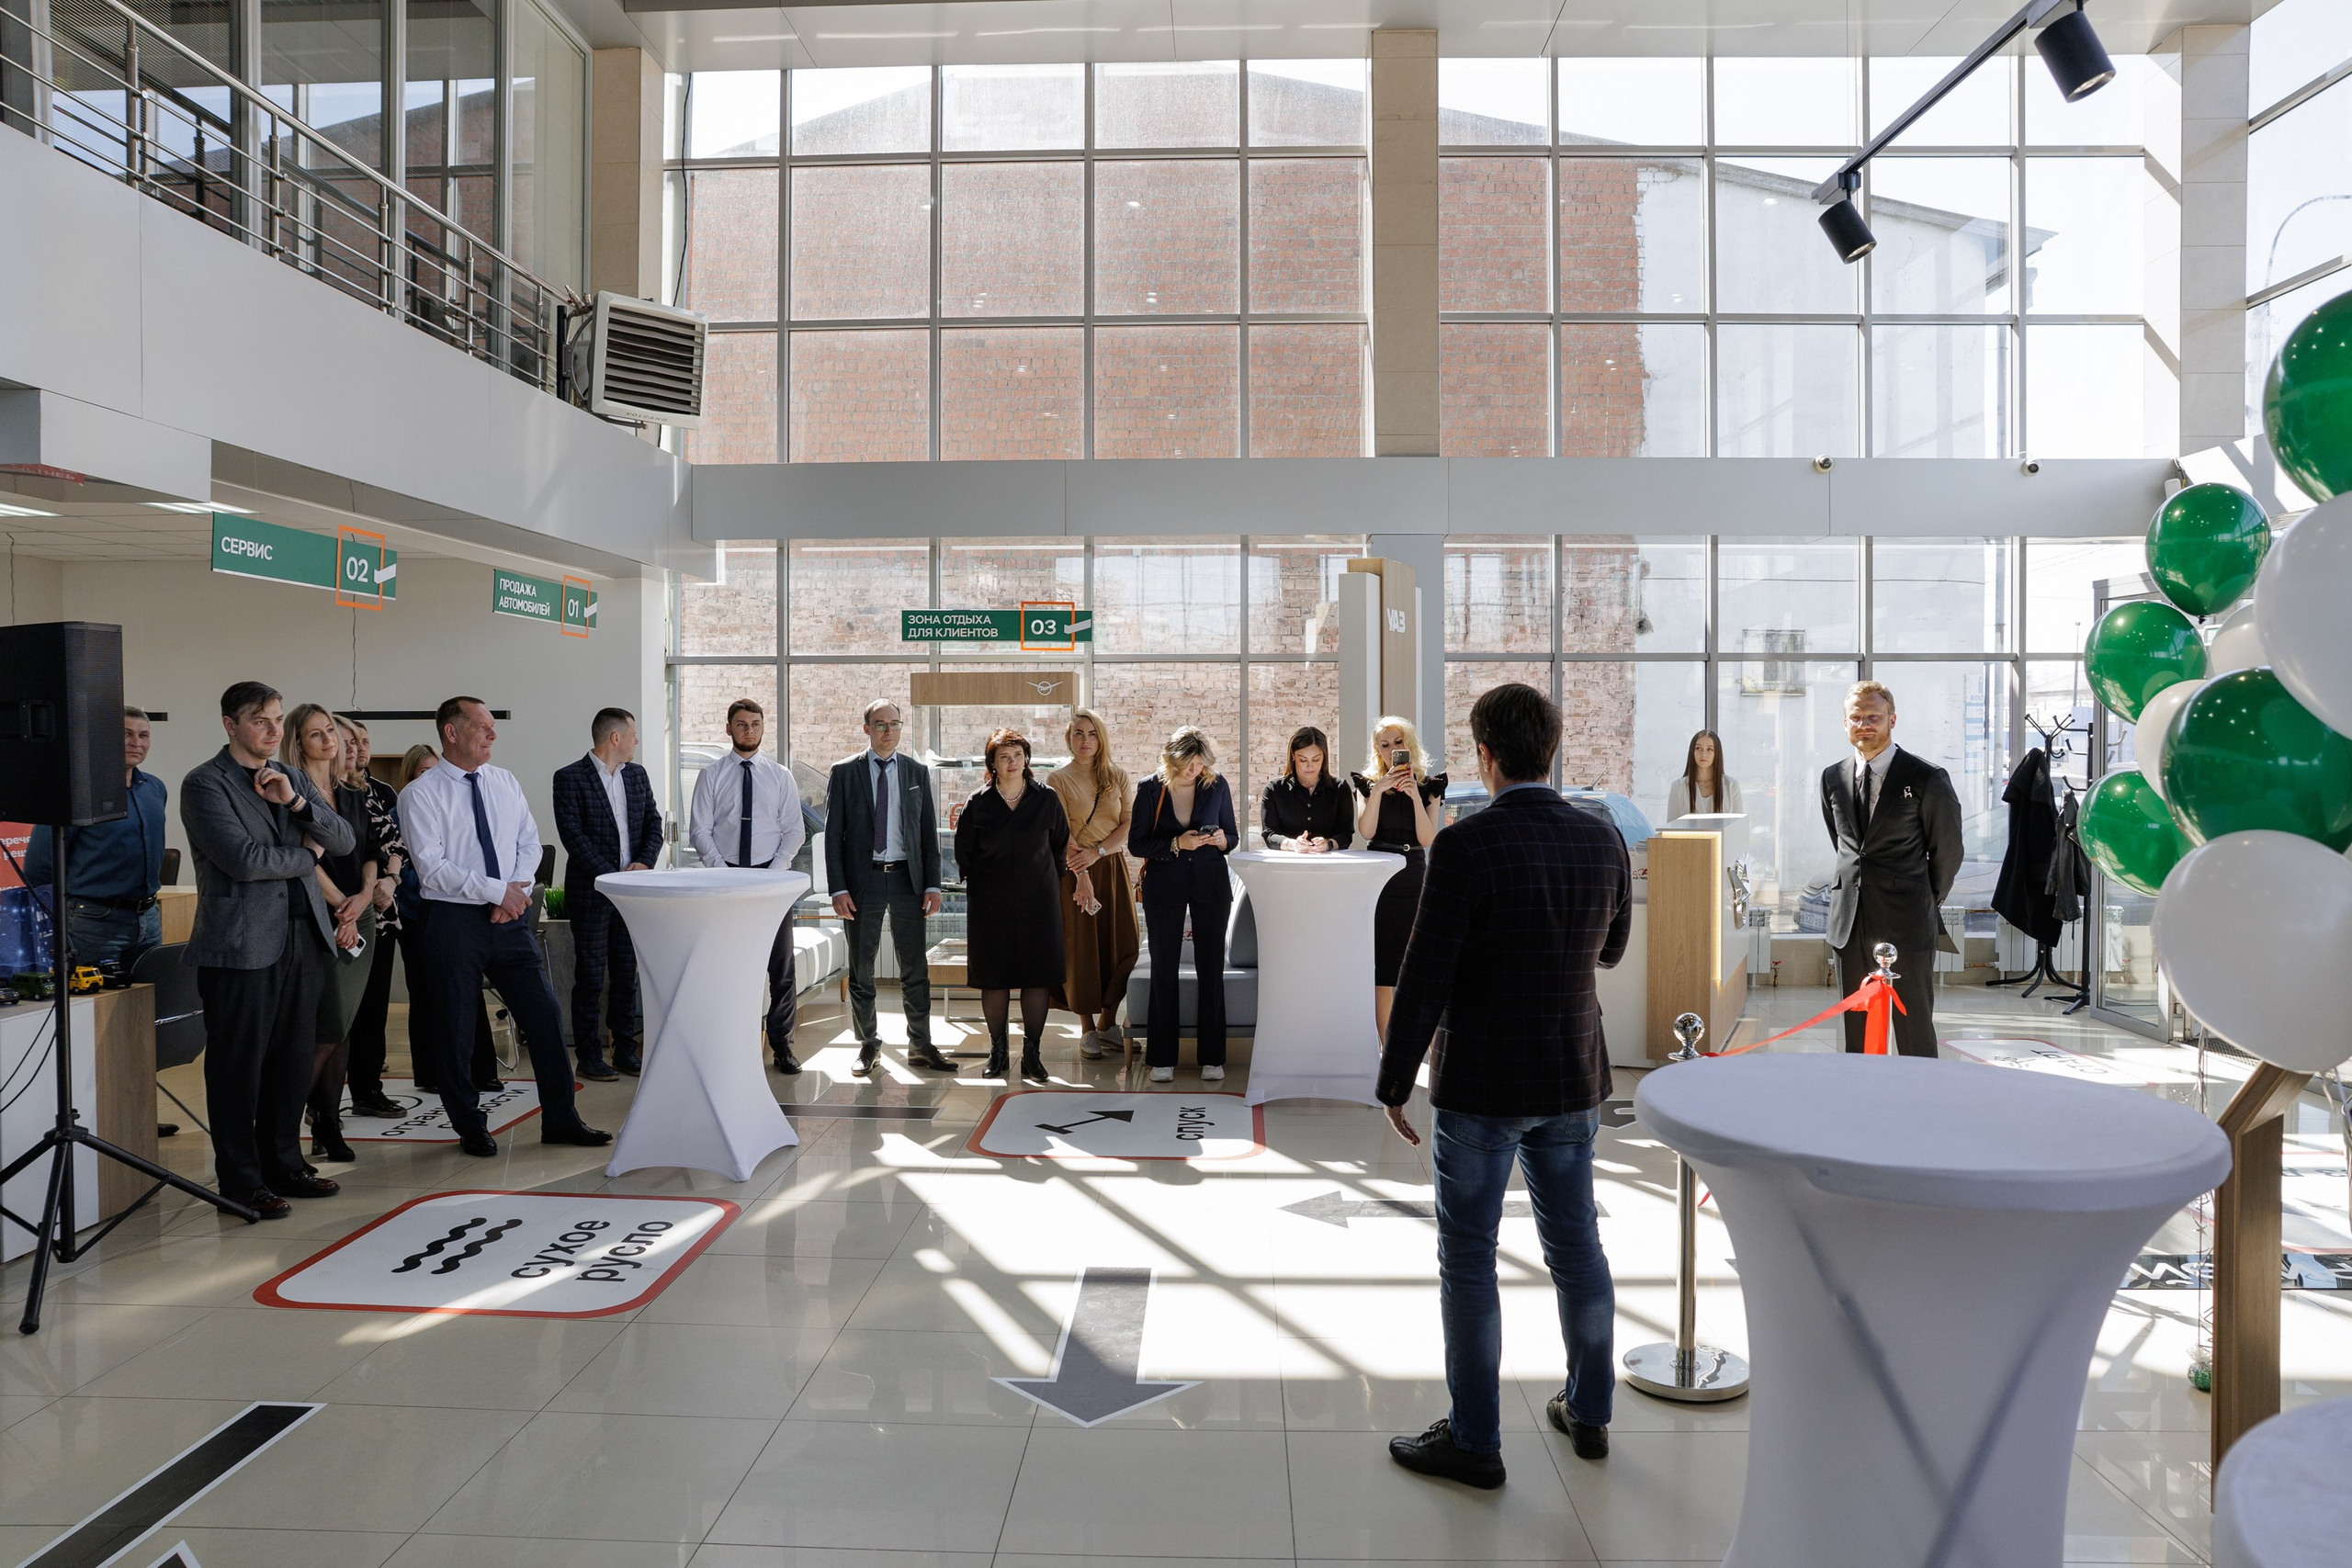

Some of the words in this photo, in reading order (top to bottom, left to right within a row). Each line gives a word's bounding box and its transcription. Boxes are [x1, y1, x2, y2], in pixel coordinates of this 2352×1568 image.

[220, 536, 273, 560] СЕРВИС
[346, 557, 368, 582] 02
[499, 578, 537, 597] ПРОДАЖА
[499, 596, 550, 616] АВТОМОБИЛЕЙ
[568, 599, 580, 618] 01
[908, 615, 941, 625] ЗОНА
[943, 615, 991, 626] ОТДЫХА
[1031, 619, 1057, 636] 03
[1386, 607, 1406, 634] УАЗ
[908, 628, 933, 638] ДЛЯ
[935, 628, 999, 637] КЛИЕНТОВ
[1176, 1107, 1216, 1140] спуск
[511, 1220, 611, 1280] сухое
[575, 1221, 674, 1282] русло
